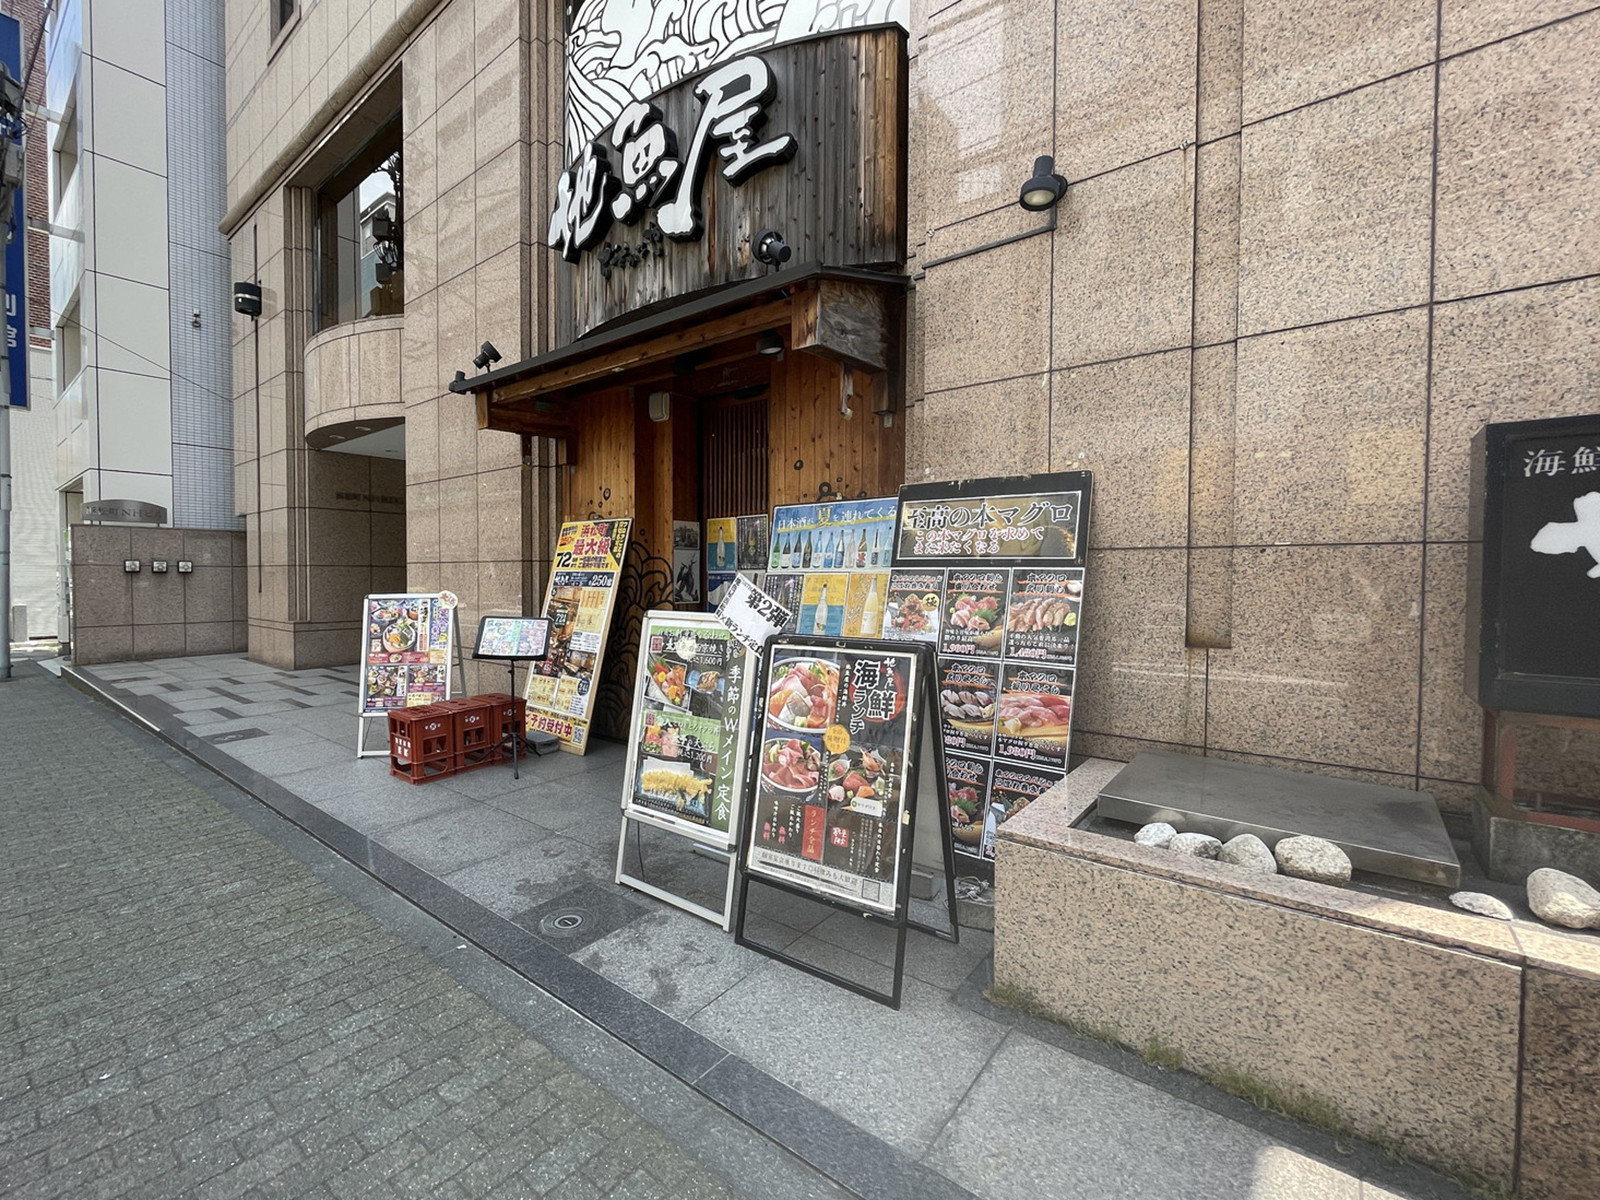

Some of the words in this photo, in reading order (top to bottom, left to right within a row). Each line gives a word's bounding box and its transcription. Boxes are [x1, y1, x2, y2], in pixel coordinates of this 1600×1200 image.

[548, 55, 792, 260] 地魚屋
[778, 505, 896, 529] 日本酒が夏を連れてくる
[907, 501, 1073, 530] 至高の本マグロ
[914, 527, 1044, 542] この本マグロを求めて
[573, 538, 612, 556] 最大級
[913, 540, 1000, 554] また来たくなる
[556, 552, 572, 568] 72
[1027, 572, 1068, 583] 本マグロ
[745, 587, 790, 628] 第2弾
[1017, 670, 1058, 683] 本マグロ
[850, 689, 868, 735] ランチ
[714, 665, 742, 821] 季節のWメイン定食
